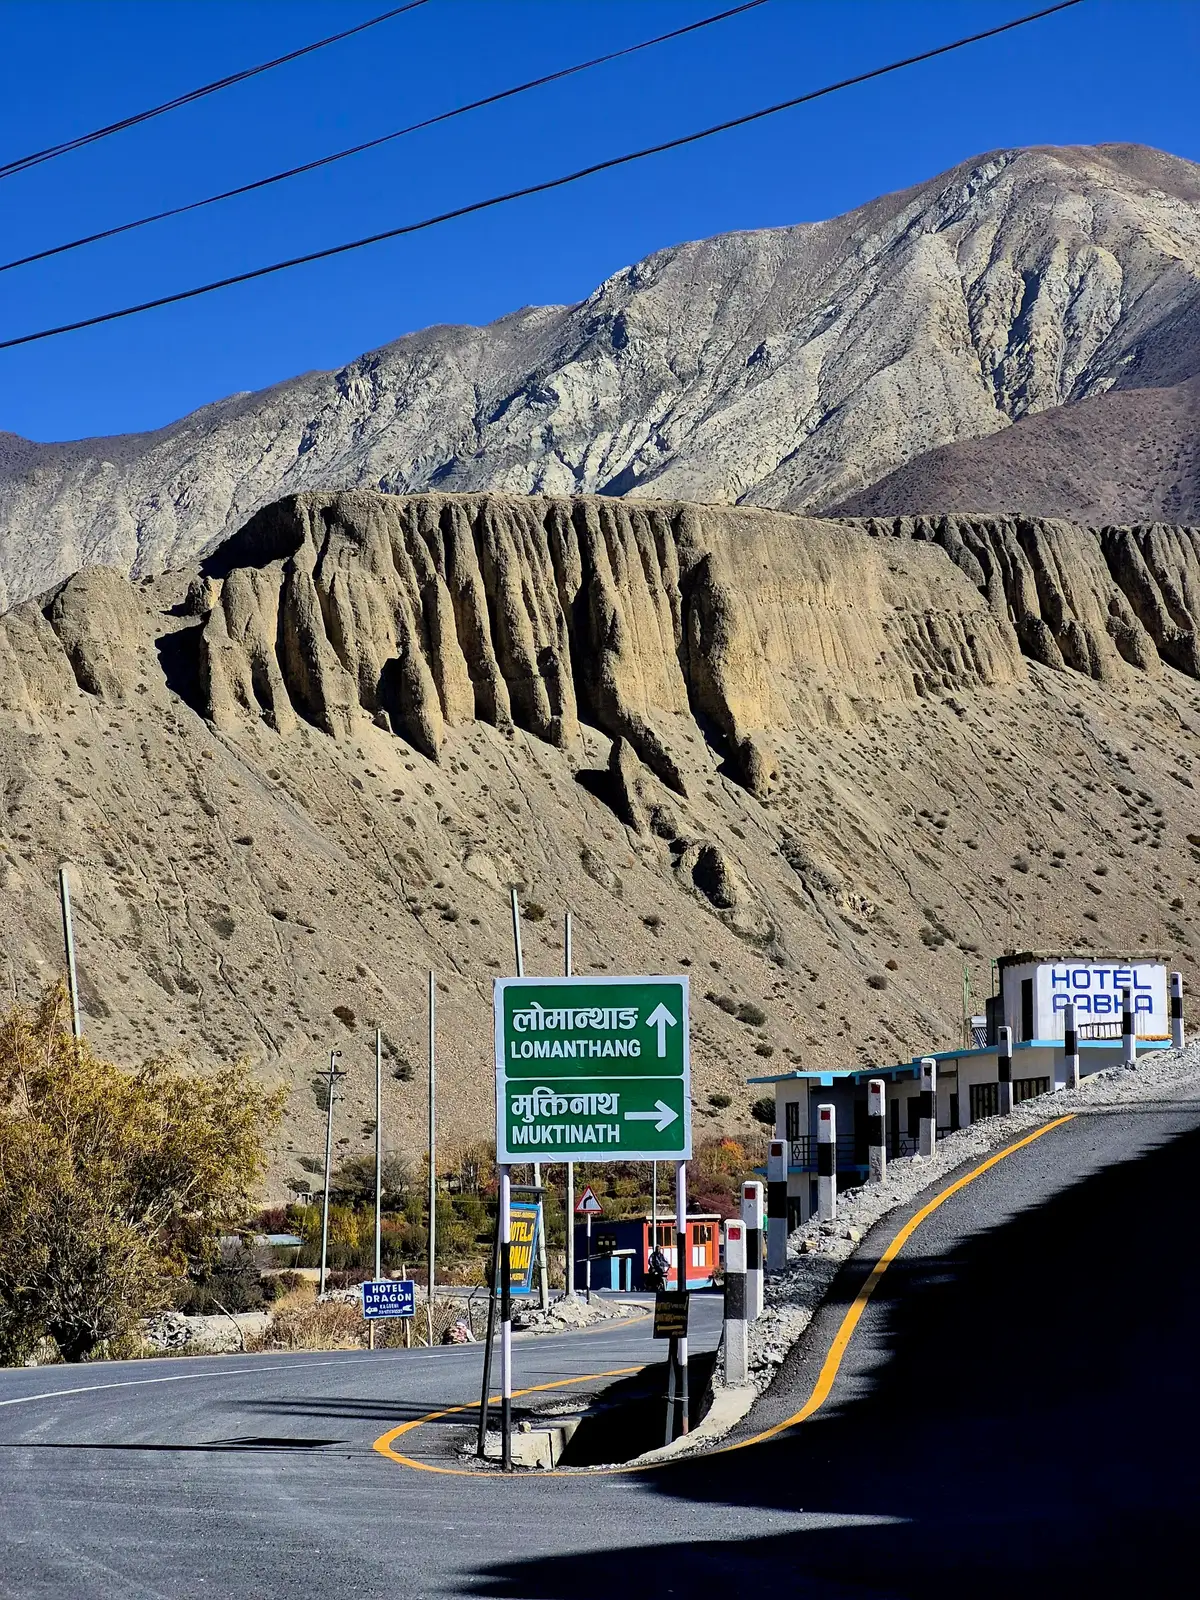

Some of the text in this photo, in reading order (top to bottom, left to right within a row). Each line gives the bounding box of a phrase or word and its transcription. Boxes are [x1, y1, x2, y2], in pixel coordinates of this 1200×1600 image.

[1051, 969, 1152, 990] HOTEL
[512, 1002, 639, 1032] लोमान्थाङ
[511, 1039, 641, 1059] LOMANTHANG
[510, 1086, 620, 1123] मुक्तिनाथ
[512, 1124, 620, 1144] MUKTINATH
[366, 1293, 412, 1303] DRAGON
[372, 1284, 404, 1294] HOTEL
